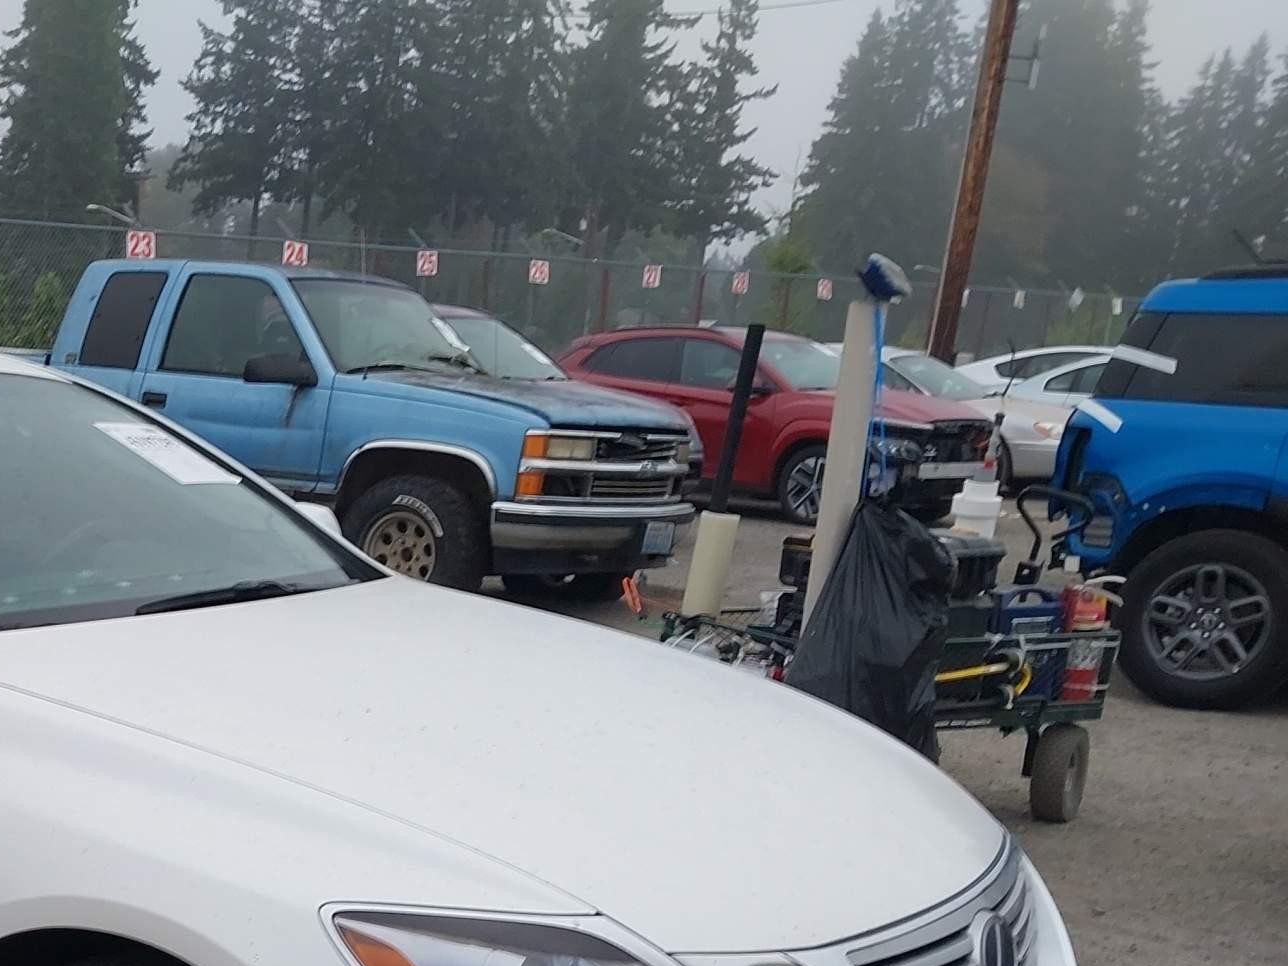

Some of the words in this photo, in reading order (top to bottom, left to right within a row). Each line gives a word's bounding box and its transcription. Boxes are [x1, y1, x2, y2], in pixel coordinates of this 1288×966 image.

[129, 232, 152, 256] 23
[285, 243, 305, 265] 24
[419, 256, 436, 274] 25
